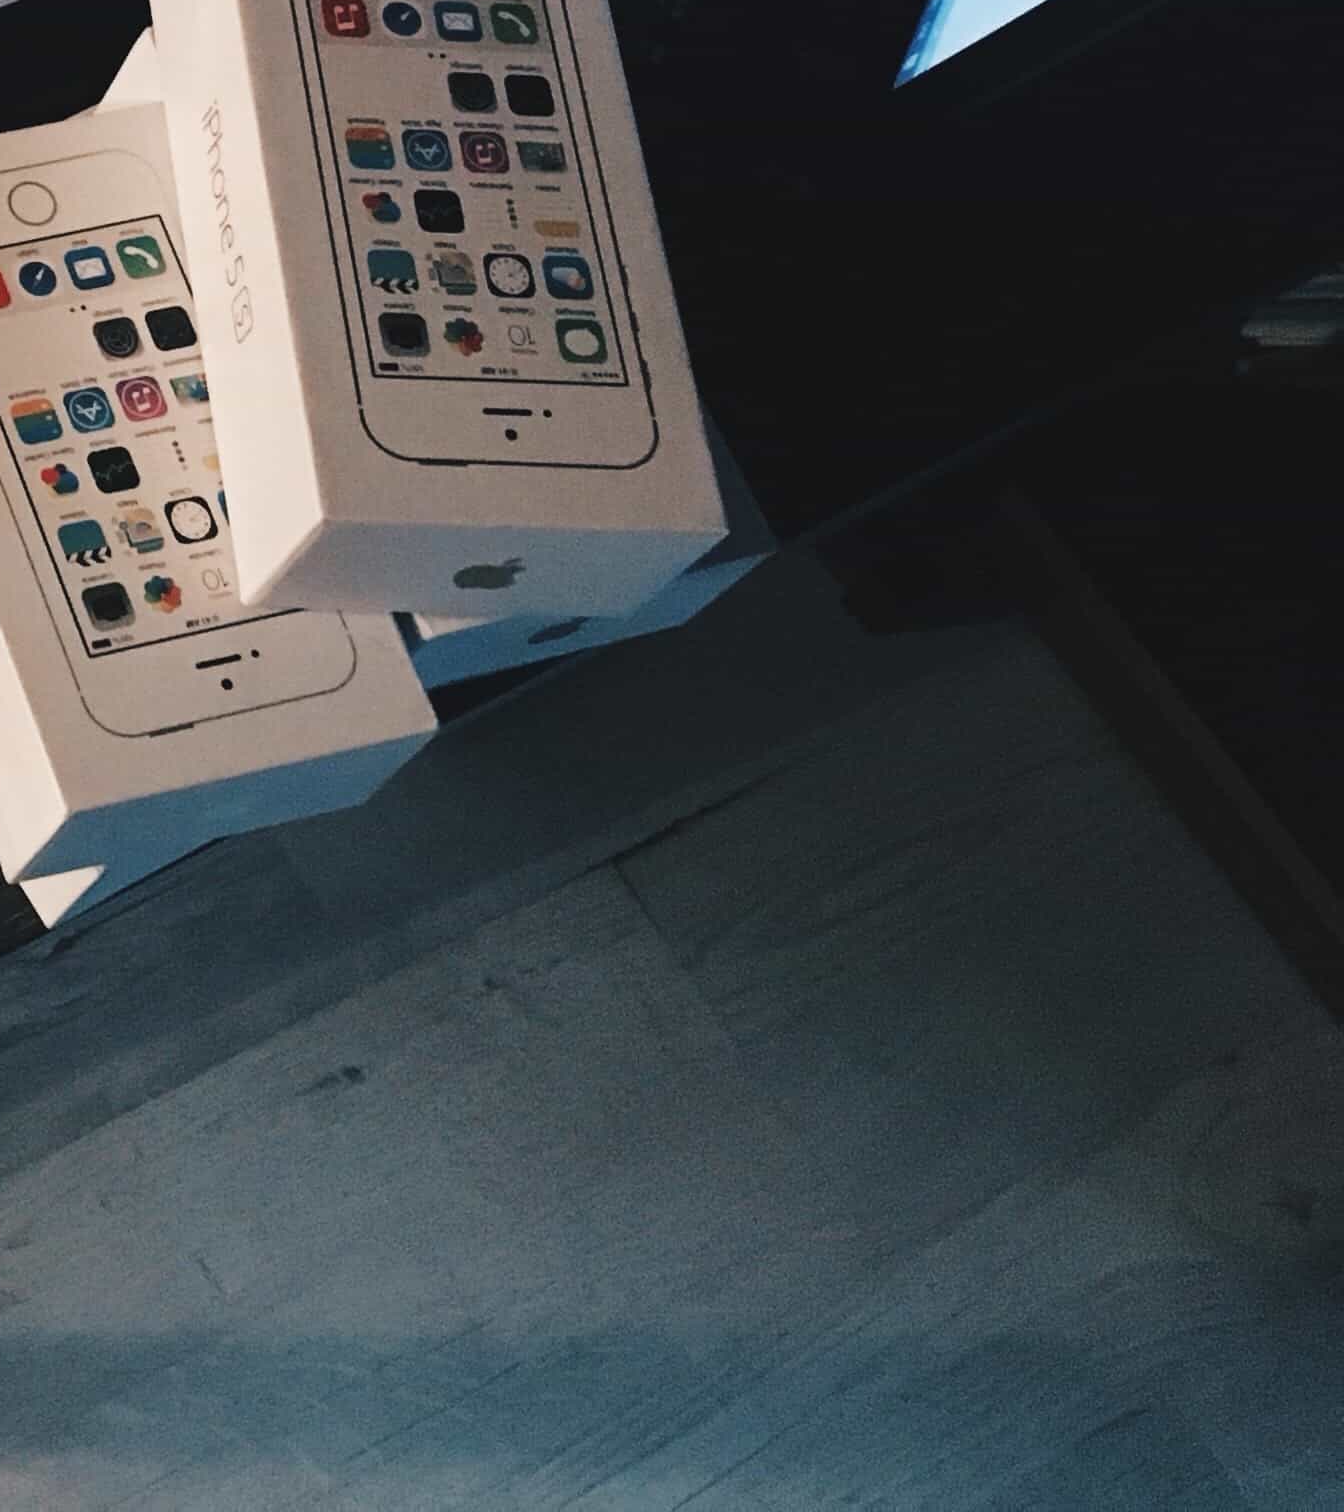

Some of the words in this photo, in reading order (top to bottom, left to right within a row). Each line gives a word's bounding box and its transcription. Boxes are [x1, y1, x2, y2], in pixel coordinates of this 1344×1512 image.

[202, 99, 234, 253] iPhone
[506, 321, 536, 347] 10
[198, 564, 230, 592] 10
